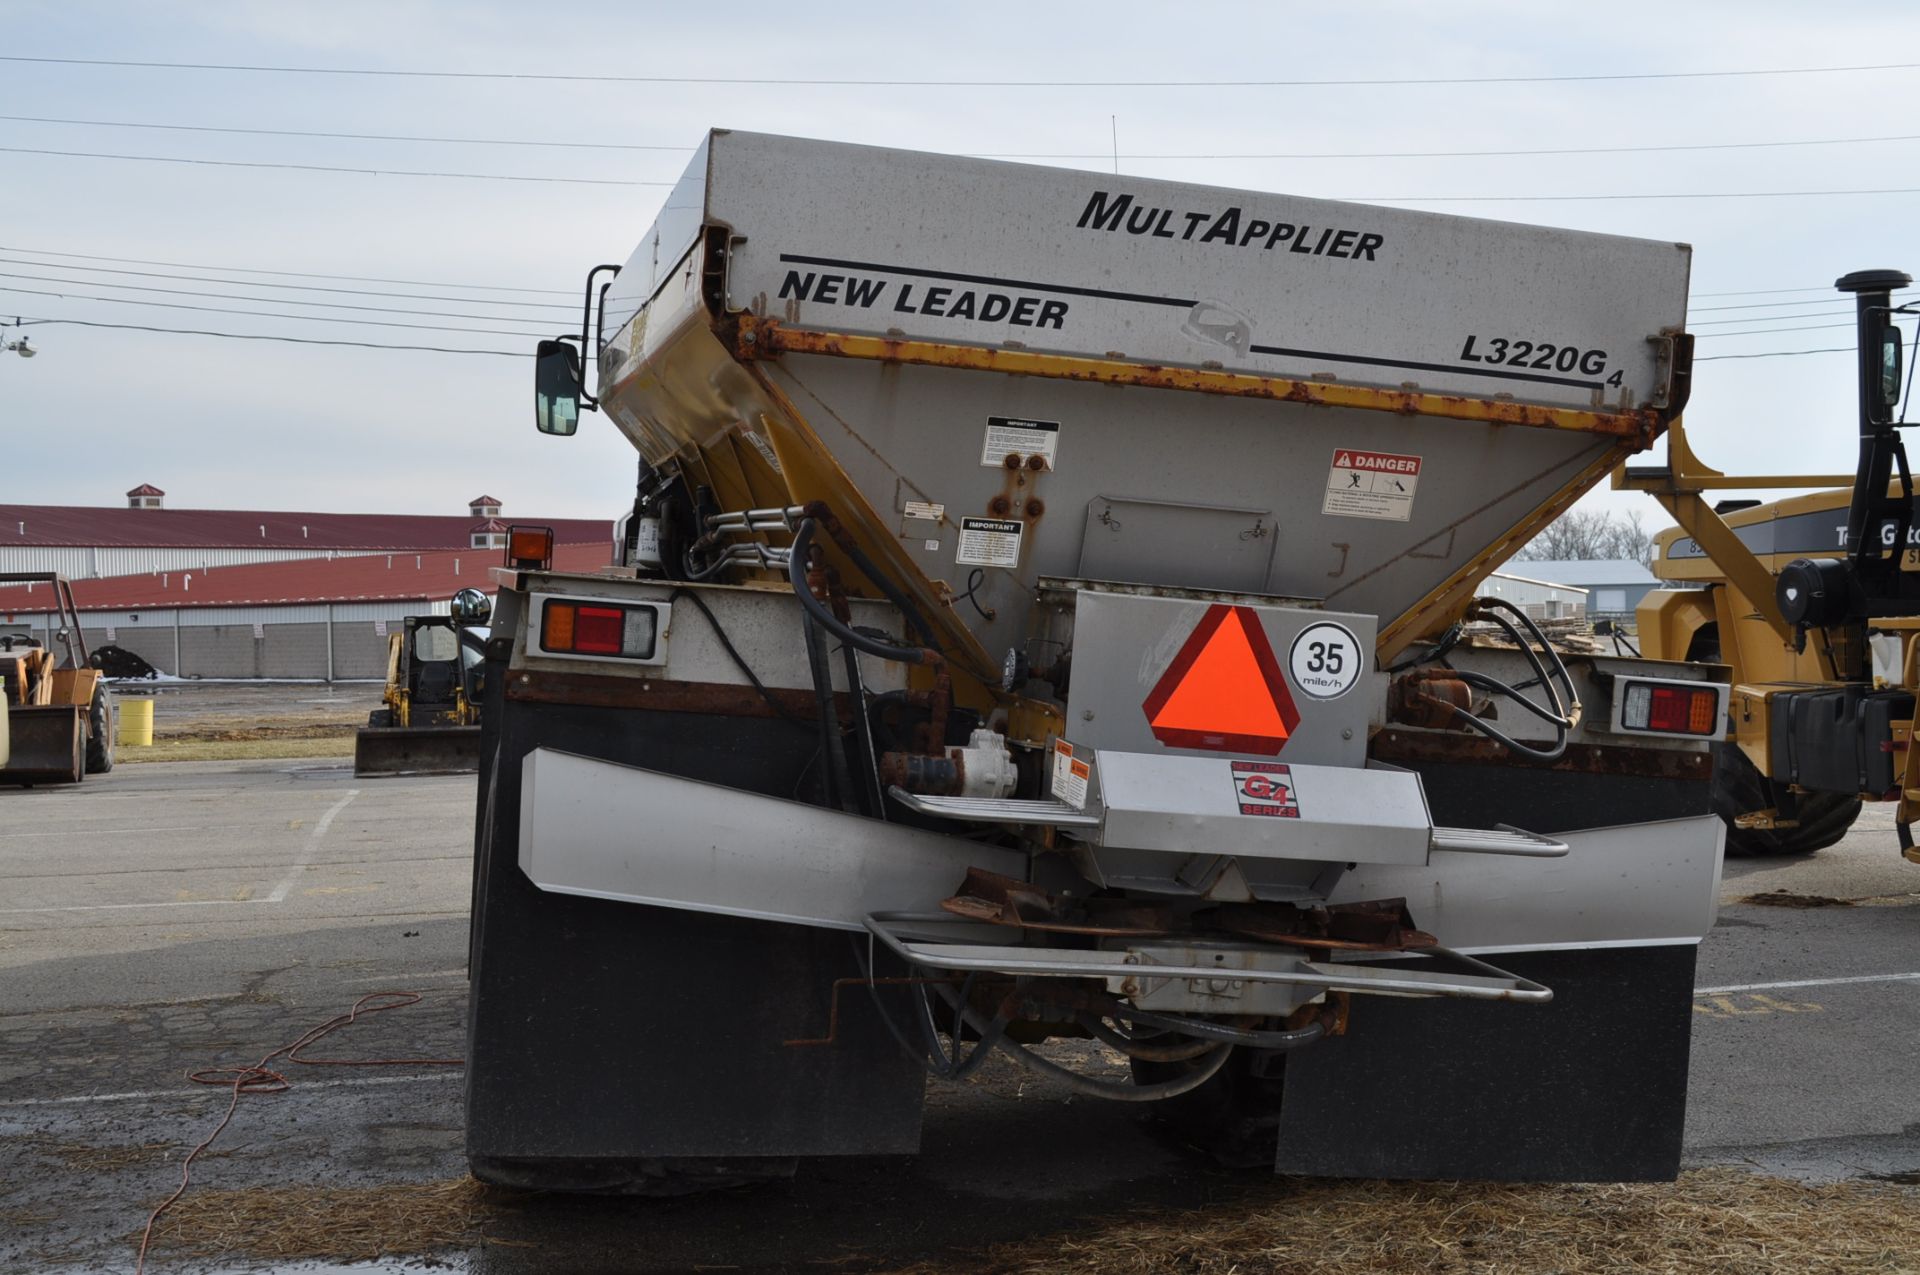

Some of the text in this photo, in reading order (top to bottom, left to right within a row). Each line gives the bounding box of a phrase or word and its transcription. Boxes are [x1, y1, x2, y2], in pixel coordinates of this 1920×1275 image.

[1076, 191, 1384, 261] MULTAPPLIER
[778, 270, 1070, 330] NEW LEADER
[1355, 456, 1417, 472] DANGER
[968, 521, 1016, 531] IMPORTANT
[1307, 641, 1344, 675] 35
[1303, 677, 1342, 688] mile/h
[1244, 774, 1288, 806] G4
[1242, 804, 1297, 817] SERIES
